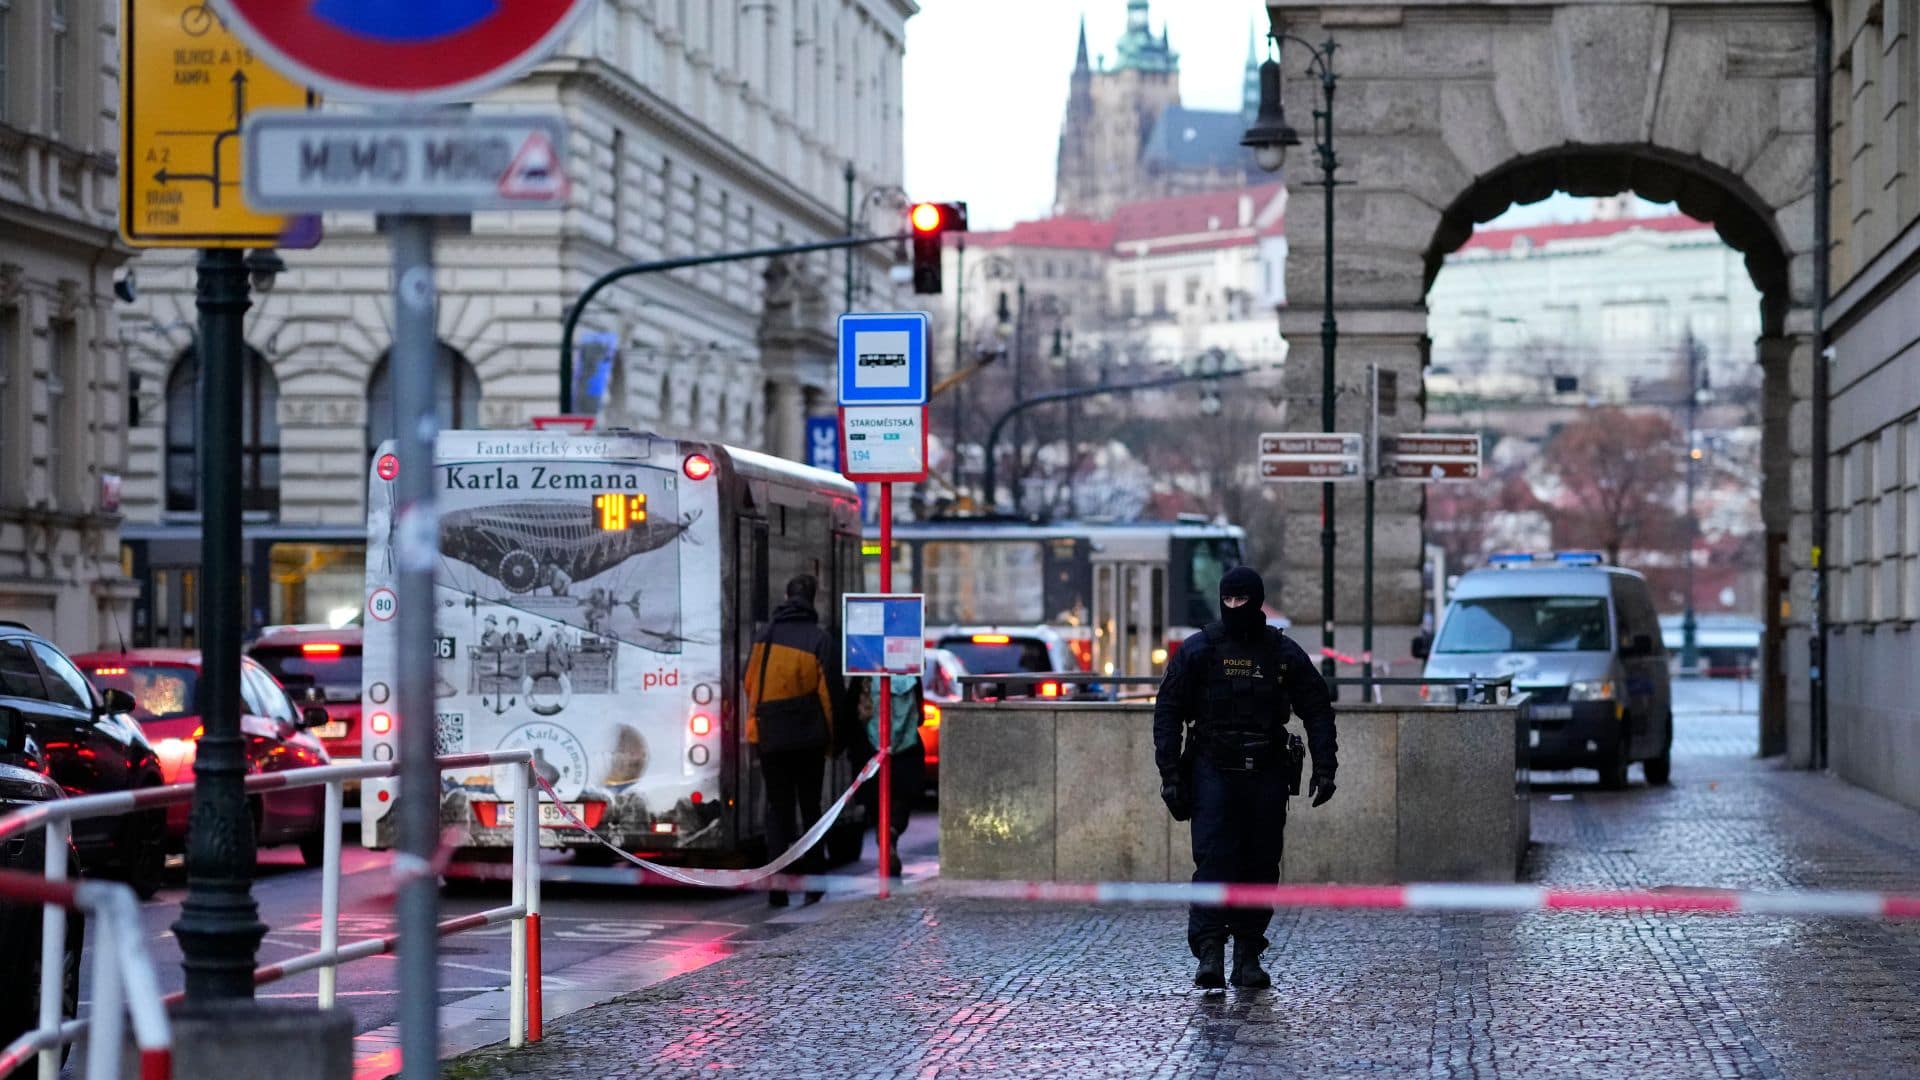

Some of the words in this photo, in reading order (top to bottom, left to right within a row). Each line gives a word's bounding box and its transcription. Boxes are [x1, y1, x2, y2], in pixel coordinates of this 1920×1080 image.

[476, 440, 568, 458] Fantastický
[853, 449, 870, 461] 194
[446, 467, 519, 489] Karla
[531, 467, 638, 489] Zemana
[376, 599, 391, 611] 80
[1223, 659, 1252, 667] POLICIE
[643, 667, 678, 690] pid
